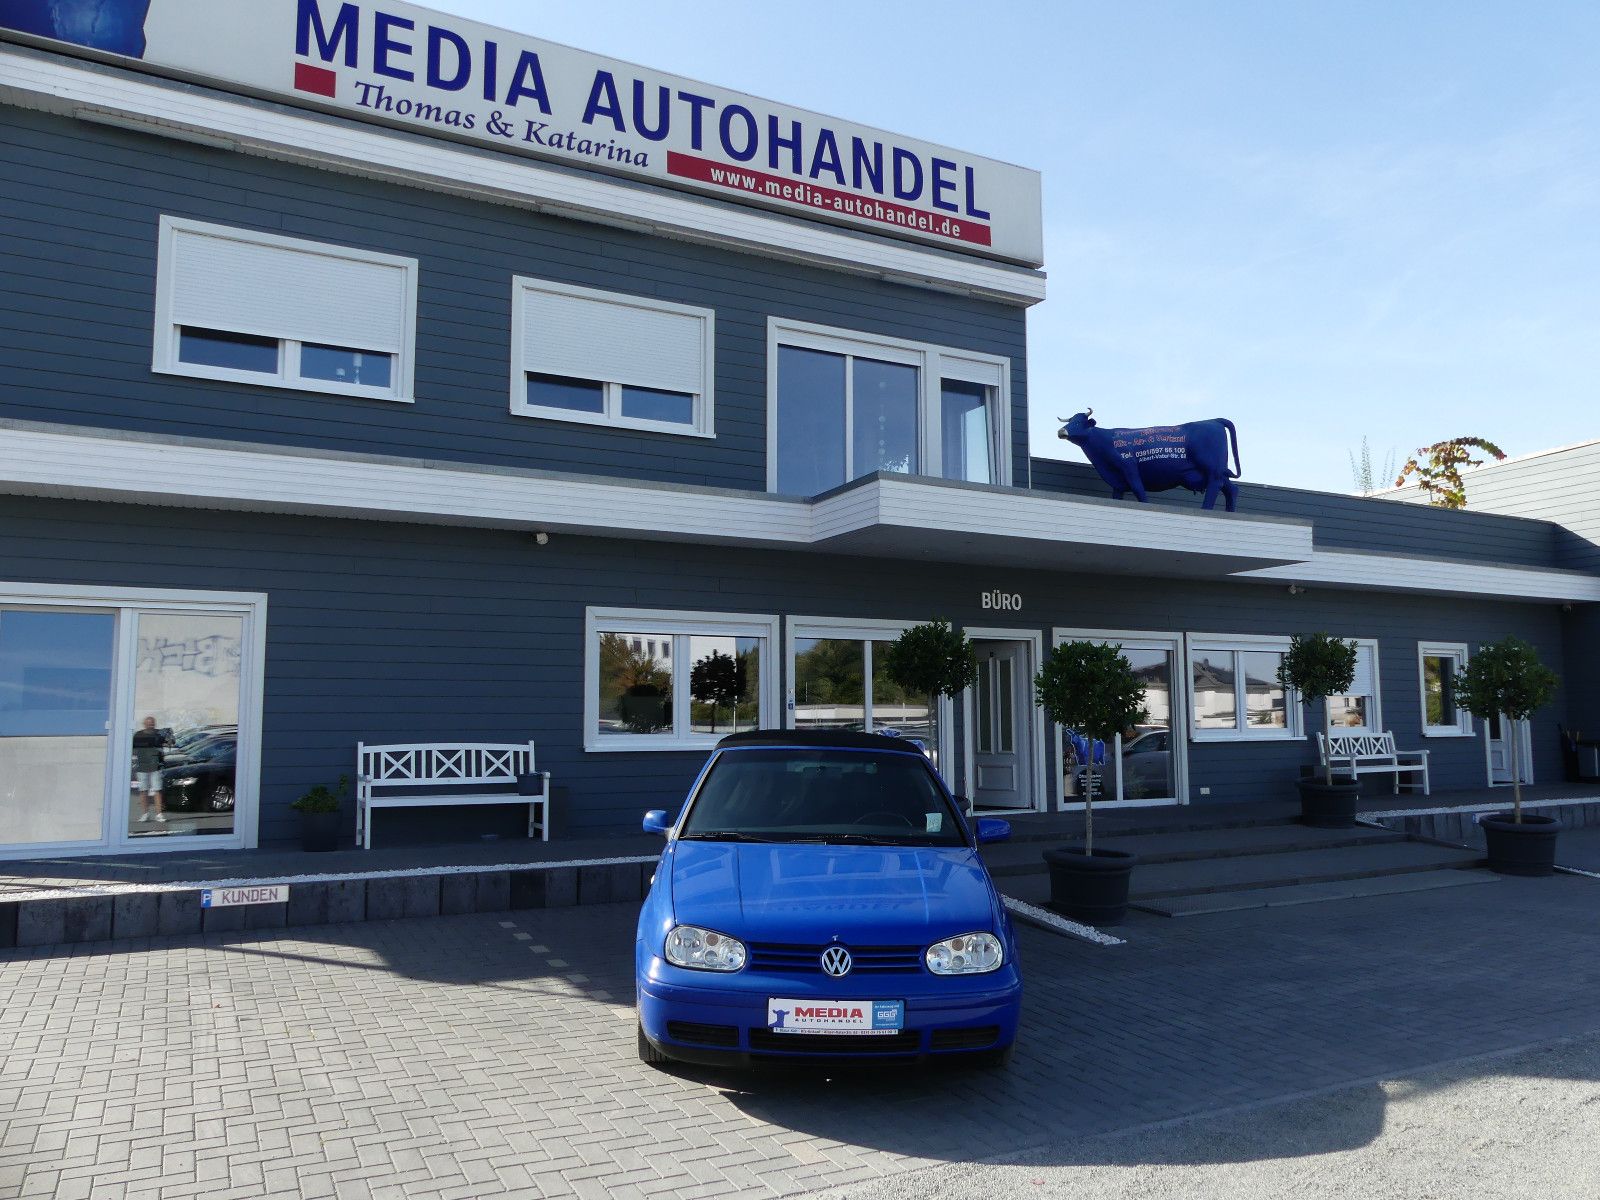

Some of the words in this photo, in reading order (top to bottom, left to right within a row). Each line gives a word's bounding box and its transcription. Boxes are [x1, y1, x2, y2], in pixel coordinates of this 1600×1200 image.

[295, 0, 552, 116] MEDIA
[581, 69, 991, 220] AUTOHANDEL
[354, 80, 476, 130] Thomas
[485, 110, 515, 138] &
[521, 119, 649, 168] Katarina
[710, 165, 961, 238] www.media-autohandel.de
[981, 590, 1022, 611] BÜRO
[203, 893, 211, 904] P
[222, 888, 278, 904] KUNDEN
[795, 1007, 863, 1018] MEDIA
